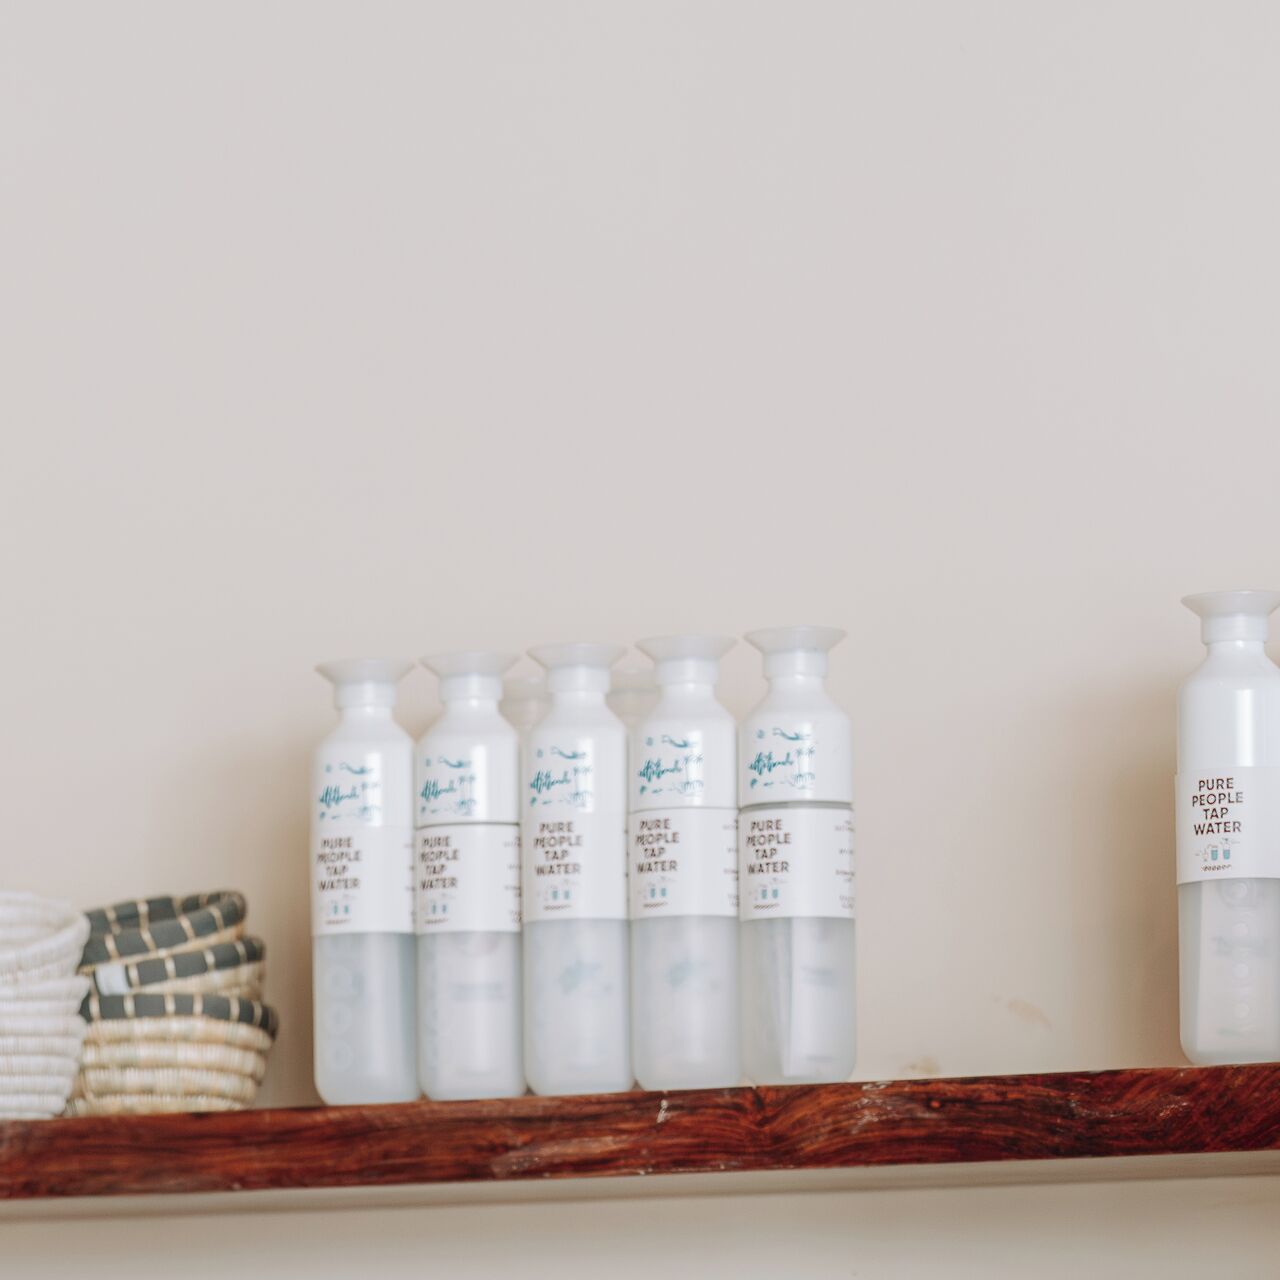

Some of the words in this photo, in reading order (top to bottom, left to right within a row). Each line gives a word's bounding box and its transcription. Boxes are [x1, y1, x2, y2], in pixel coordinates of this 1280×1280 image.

[1199, 778, 1234, 791] PURE
[1192, 792, 1243, 807] PEOPLE
[1203, 807, 1229, 820] TAP
[540, 821, 573, 833] PURE
[640, 819, 671, 830] PURE
[751, 819, 782, 832] PURE
[1194, 821, 1242, 835] WATER
[534, 835, 582, 848] PEOPLE
[636, 832, 679, 846] PEOPLE
[746, 833, 791, 846] PEOPLE
[545, 850, 569, 861] TAP
[643, 847, 666, 859] TAP
[755, 848, 777, 860] TAP
[535, 863, 581, 876] WATER
[637, 860, 677, 874] WATER
[747, 861, 789, 875] WATER
